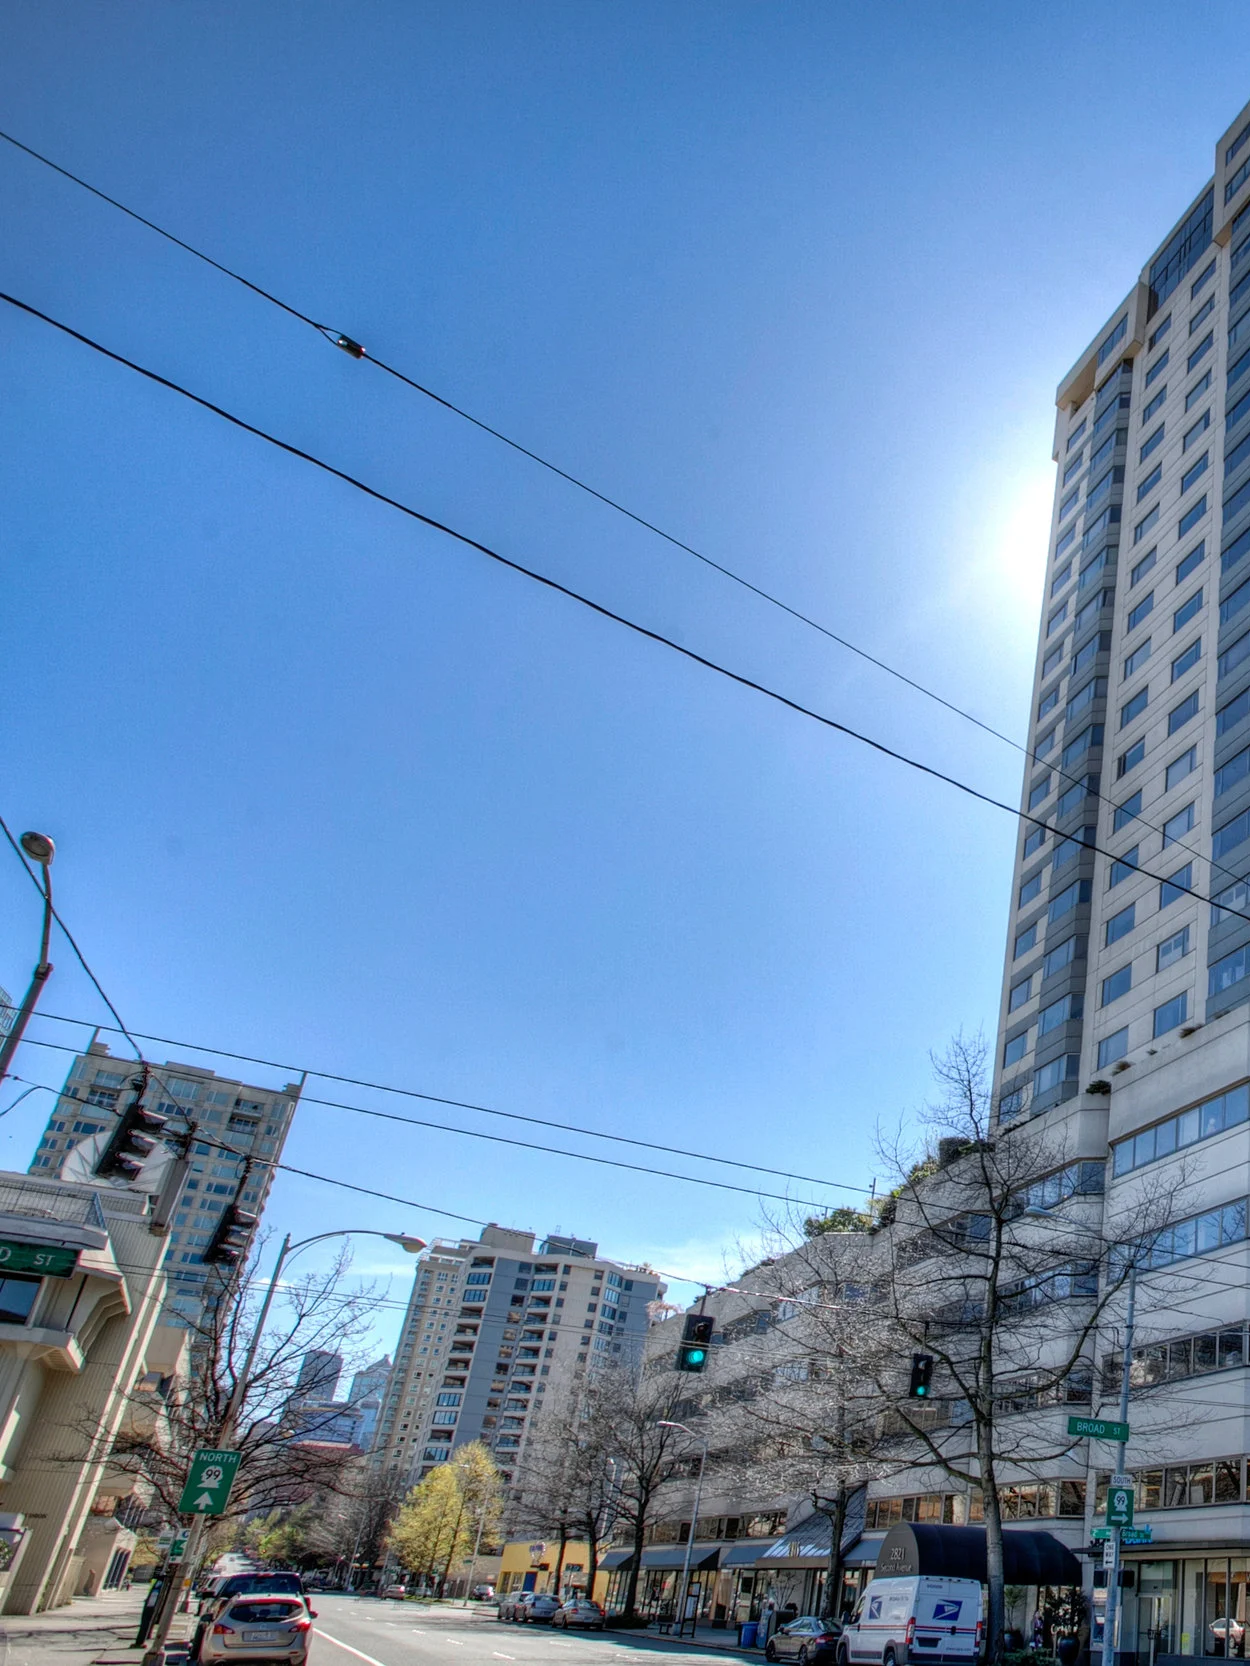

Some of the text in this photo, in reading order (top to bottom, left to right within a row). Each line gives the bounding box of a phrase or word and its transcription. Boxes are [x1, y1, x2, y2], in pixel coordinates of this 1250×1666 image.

[33, 1253, 55, 1266] ST
[1076, 1421, 1121, 1435] BROAD ST
[199, 1451, 238, 1463] NORTH
[205, 1468, 221, 1480] 99
[1112, 1475, 1131, 1485] SOUTH
[1116, 1495, 1126, 1505] 99
[1105, 1543, 1114, 1551] ONE
